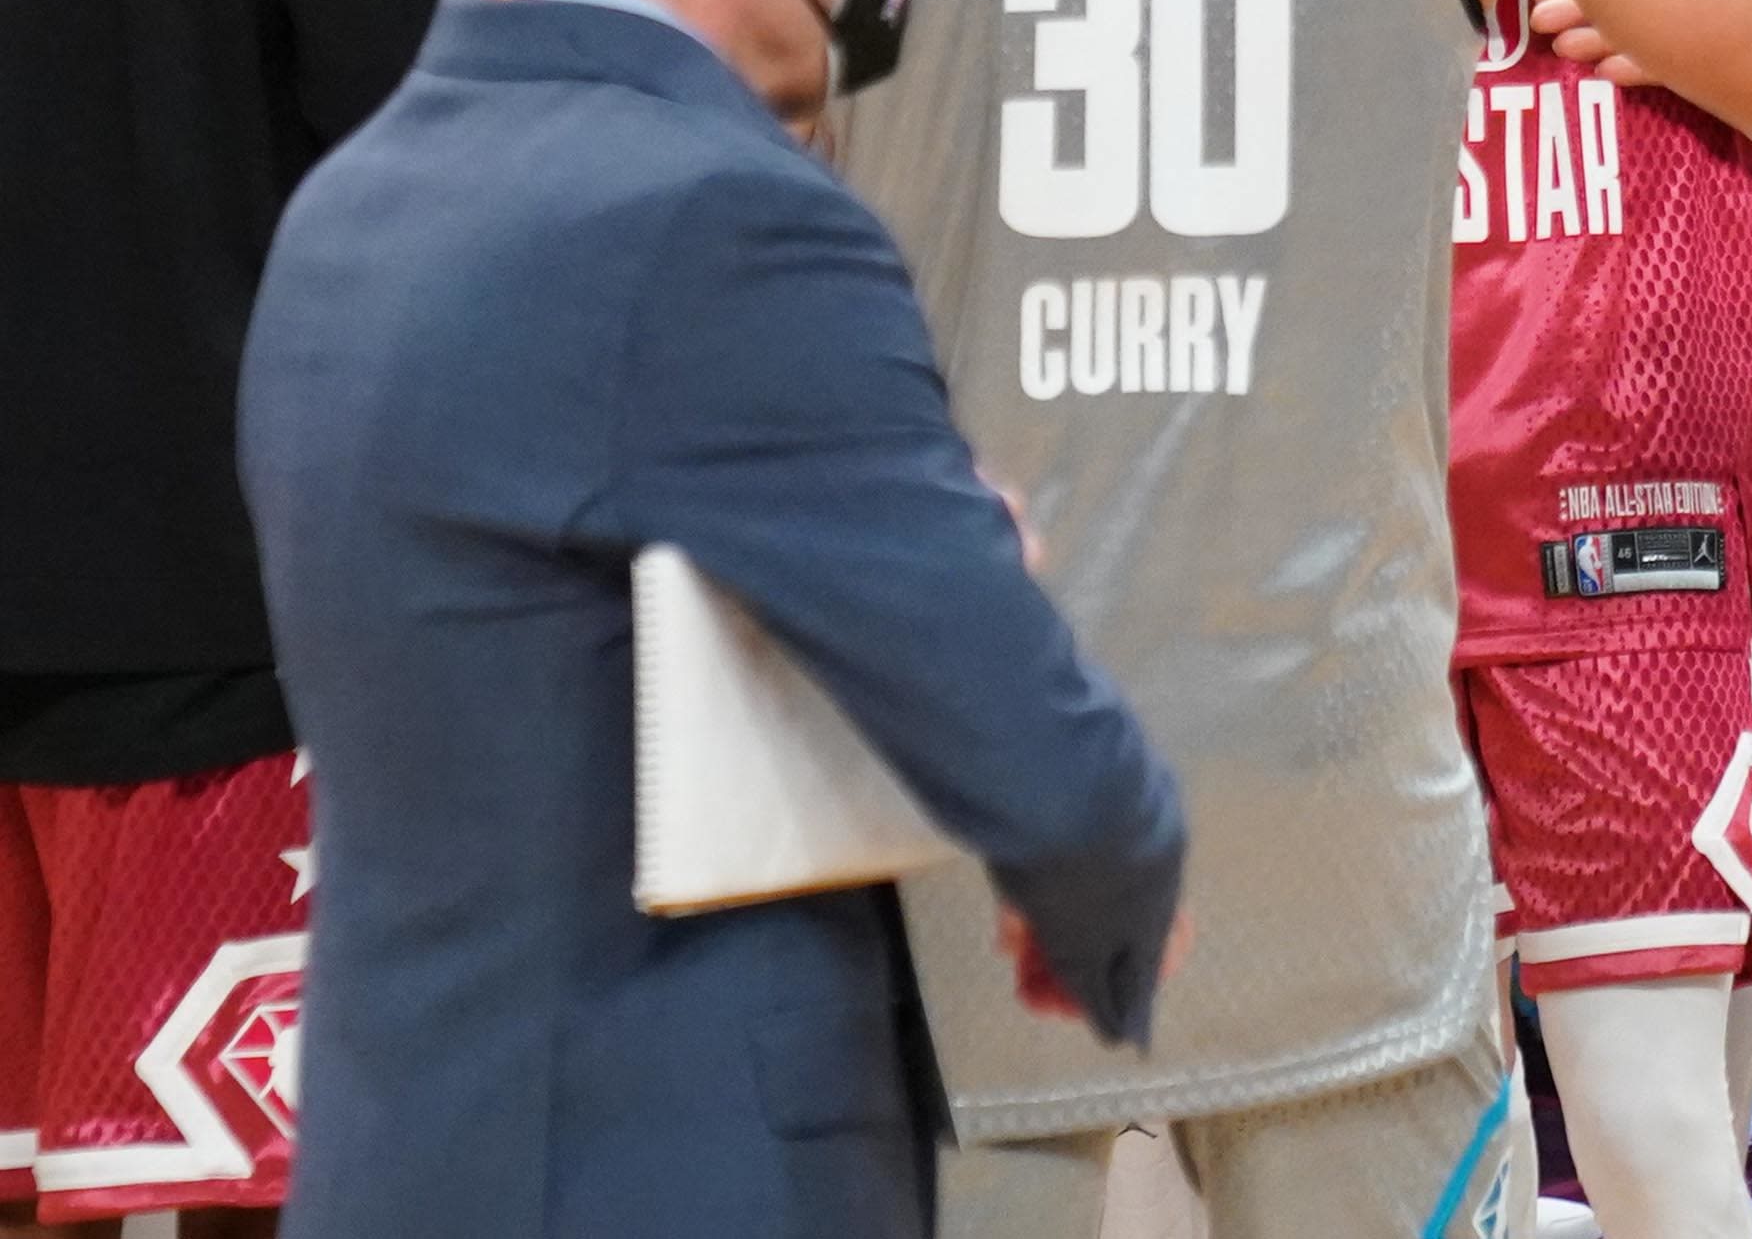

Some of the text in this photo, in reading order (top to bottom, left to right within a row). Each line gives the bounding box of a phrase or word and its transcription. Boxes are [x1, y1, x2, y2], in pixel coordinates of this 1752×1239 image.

[1452, 78, 1623, 243] STAR
[1020, 275, 1267, 401] CURRY
[1567, 486, 1601, 520] NBA
[1605, 482, 1674, 518] ALL-STAR
